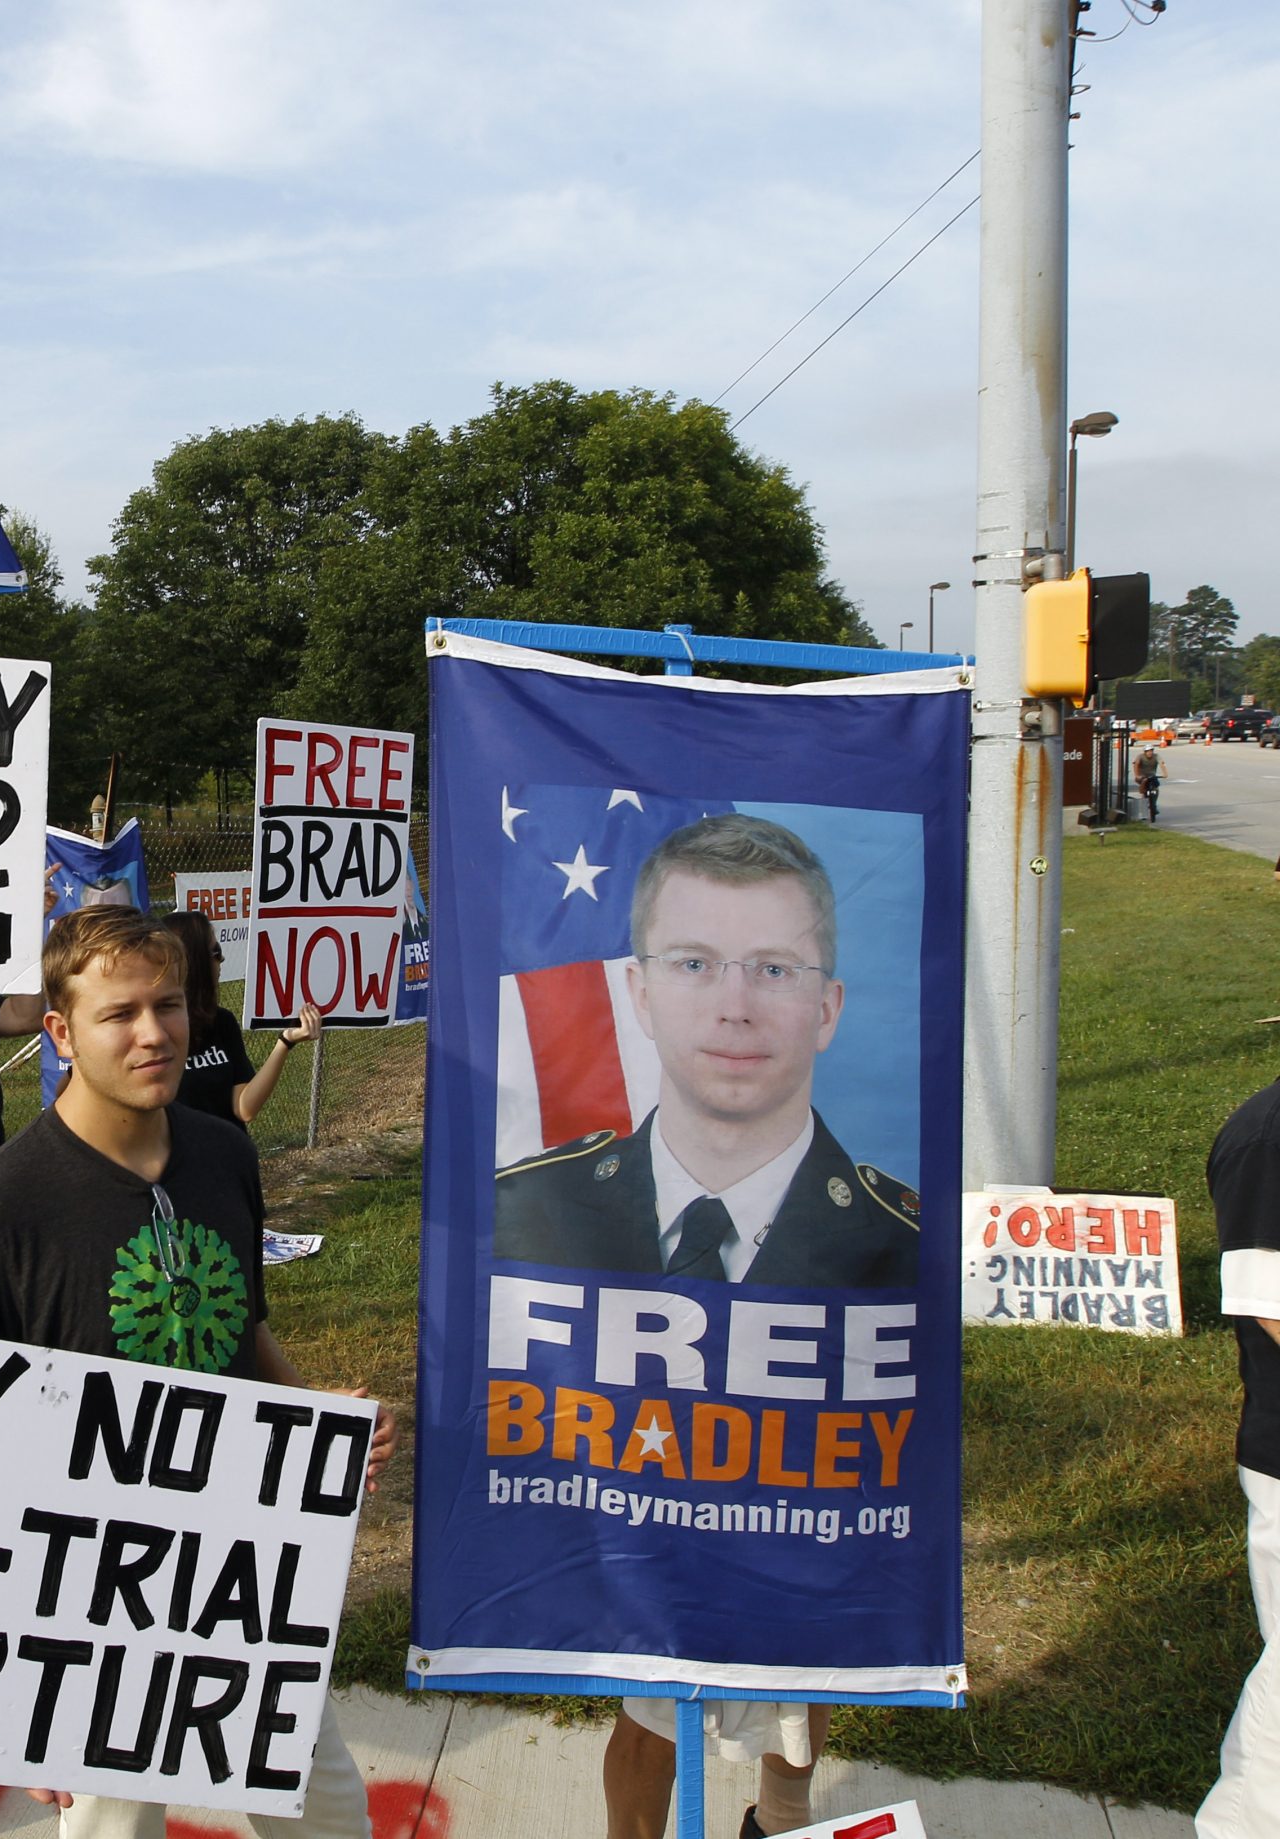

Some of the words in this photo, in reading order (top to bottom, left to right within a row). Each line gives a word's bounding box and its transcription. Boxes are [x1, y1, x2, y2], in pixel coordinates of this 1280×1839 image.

[264, 728, 410, 810] FREE
[259, 820, 402, 902] BRAD
[187, 887, 237, 921] FREE
[255, 926, 400, 1017] NOW
[983, 1205, 1162, 1256] HERO!
[488, 1275, 916, 1401] FREE
[985, 1288, 1168, 1330] BRADLEY
[69, 1371, 227, 1492] NO
[255, 1401, 373, 1516] TO
[487, 1380, 914, 1488] BRADLEY
[488, 1469, 910, 1544] bradleymanning.org
